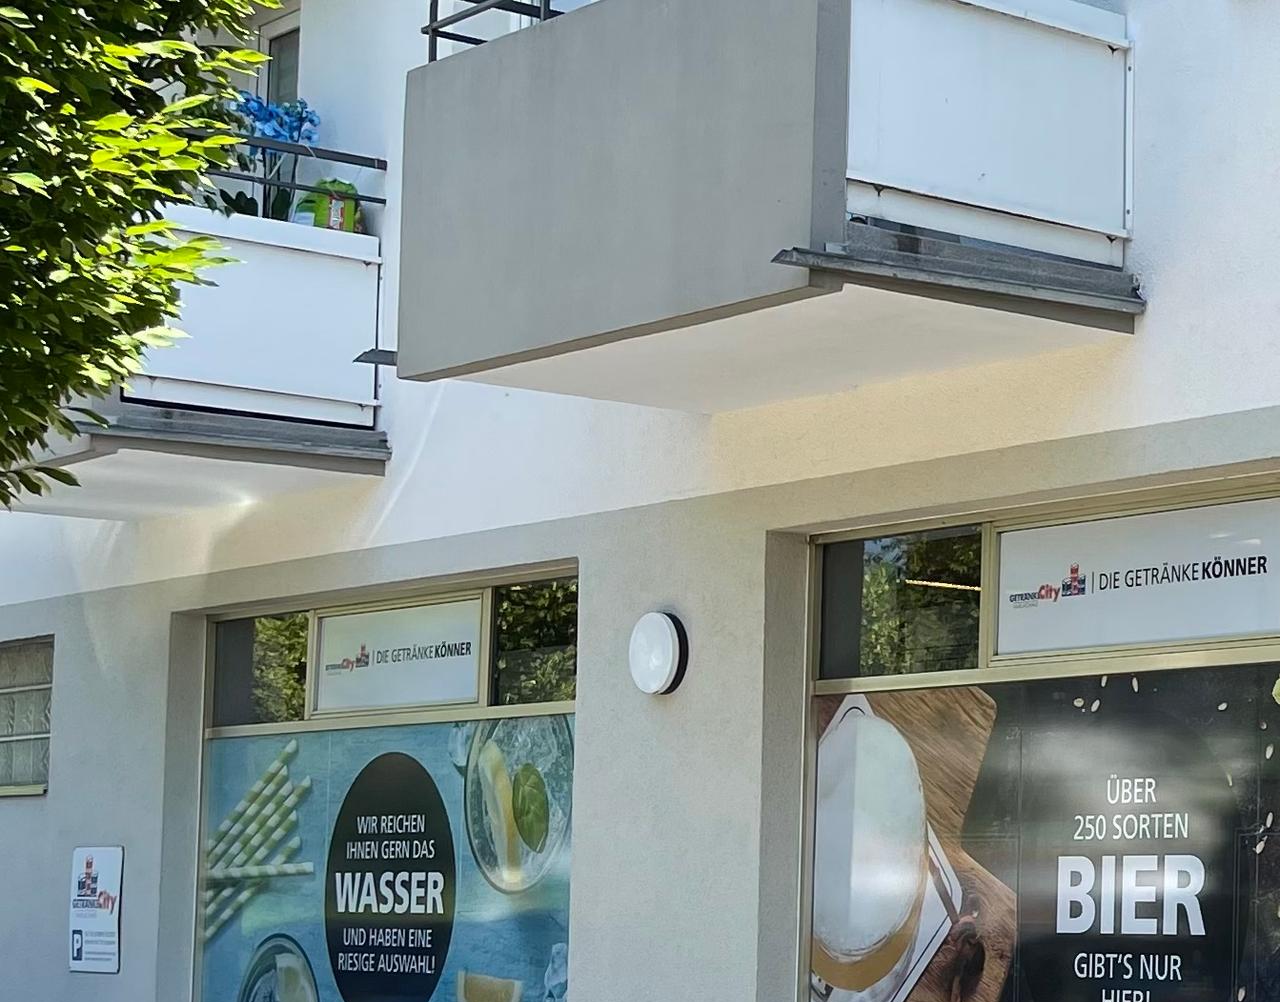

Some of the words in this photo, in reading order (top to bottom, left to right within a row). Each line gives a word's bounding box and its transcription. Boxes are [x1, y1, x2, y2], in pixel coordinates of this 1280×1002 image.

[1099, 571, 1121, 591] DIE
[1124, 562, 1200, 588] GETRÄNKE
[1200, 555, 1268, 580] KÖNNER
[376, 649, 389, 664] DIE
[391, 644, 434, 663] GETRÄNKE
[434, 641, 472, 659] KÖNNER
[1106, 774, 1157, 805] ÜBER
[357, 815, 378, 834] WIR
[380, 814, 425, 834] REICHEN
[1073, 815, 1107, 840] 250
[1112, 813, 1189, 840] SORTEN
[346, 841, 378, 860] IHNEN
[381, 840, 410, 859] GERN
[413, 840, 435, 859] DAS
[335, 871, 445, 914] WASSER
[1056, 854, 1206, 936] BIER
[343, 928, 366, 946] UND
[369, 928, 406, 947] HABEN
[408, 929, 432, 948] EINE
[338, 953, 375, 972] RIESIGE
[377, 953, 436, 974] AUSWAHL!
[1139, 954, 1182, 981] NUR
